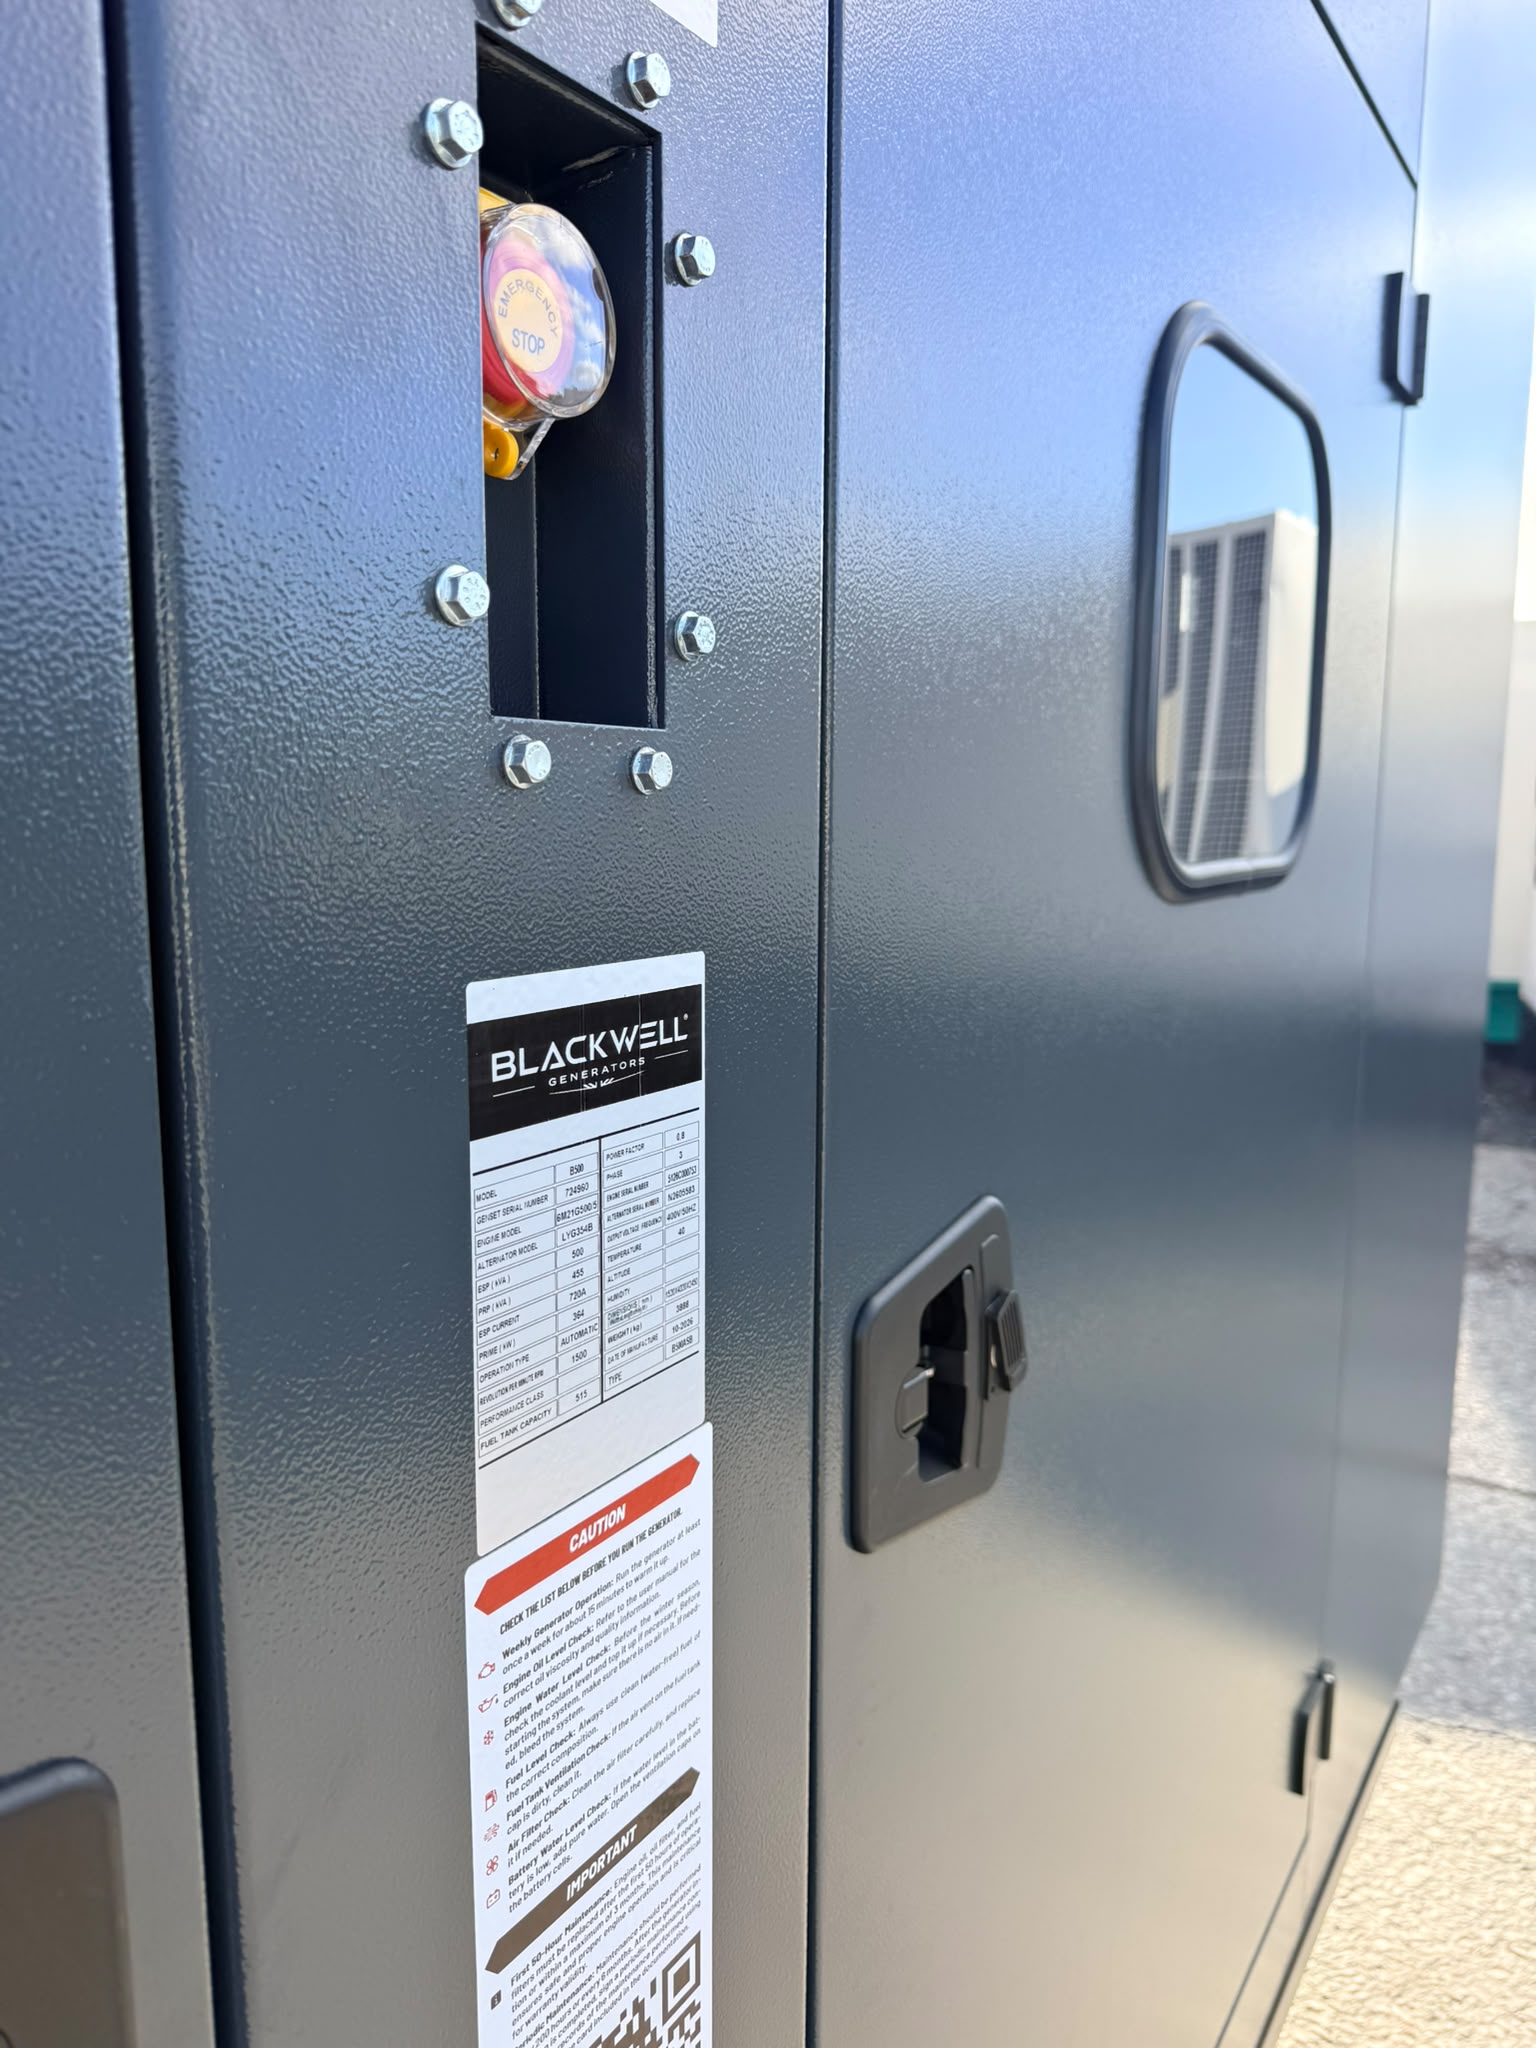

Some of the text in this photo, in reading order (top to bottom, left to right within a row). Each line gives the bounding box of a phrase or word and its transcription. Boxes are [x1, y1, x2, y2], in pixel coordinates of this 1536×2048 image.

[499, 280, 558, 338] EMERGENCY
[512, 328, 546, 356] STOP
[491, 1016, 689, 1083] BLACKWELL
[548, 1057, 646, 1088] GENERATORS
[605, 1148, 624, 1161] POWER
[625, 1142, 645, 1155] FACTOR
[606, 1169, 623, 1180] PHASE
[475, 1162, 584, 1202] MODEL B500
[606, 1190, 620, 1202] ENGINE
[633, 1180, 649, 1192] NUMBER
[476, 1209, 501, 1225] GENSET
[502, 1203, 523, 1216] SERIAL
[523, 1194, 548, 1208] NUMBER
[606, 1207, 631, 1222] ALTERNATOR
[644, 1196, 659, 1208] NUMBER
[476, 1232, 500, 1248] ENGINE
[500, 1226, 522, 1239] MODEL
[477, 1222, 593, 1271] ALTERNATOR MODEL LYG354B
[607, 1242, 642, 1262] TEMPERATURE
[477, 1281, 490, 1294] ESP
[571, 1246, 584, 1259] 500
[477, 1304, 491, 1316] PRP
[571, 1267, 584, 1279] 455
[607, 1267, 631, 1283] ALTITUDE
[607, 1287, 630, 1302] HUMIDITY
[478, 1287, 586, 1339] ESP CURRENT 720A
[478, 1345, 498, 1361] PRIME
[572, 1308, 585, 1321] 364
[607, 1327, 629, 1344] WEIGHT
[479, 1322, 598, 1384] OPERATION TYPE AUTOMATIC
[607, 1352, 620, 1364] DATE
[626, 1333, 658, 1354] MANUFACTURE
[479, 1386, 508, 1406] REVOLUTION
[571, 1348, 587, 1363] 1500
[608, 1370, 622, 1385] TYPE
[480, 1390, 544, 1428] PERFORMANCE CLASS
[480, 1388, 588, 1451] FUEL TANK CAPACITY 515
[569, 1503, 626, 1552] CAUTION
[499, 1506, 682, 1635] CHECK THE LIST BELOW BEFORE YOU RUN THE GENERATOR.
[501, 1634, 532, 1660] Weekly
[533, 1606, 573, 1639] Generator
[574, 1579, 614, 1611] Operation:
[615, 1568, 629, 1583] Run
[630, 1559, 642, 1572] the
[643, 1535, 676, 1565] generator
[685, 1518, 701, 1535] least
[502, 1655, 523, 1675] once
[530, 1635, 551, 1655] week
[552, 1627, 564, 1641] for
[564, 1610, 586, 1632] about
[595, 1585, 624, 1610] minutes
[633, 1565, 652, 1584] warm
[502, 1624, 594, 1694] Engine Oil Level Check:
[503, 1591, 660, 1708] correct oil viscosity and quality information.
[503, 1644, 611, 1728] Engine Water Level Check:
[504, 1705, 585, 1770] ed, bleed the system.
[505, 1729, 576, 1789] Fuel Level Check:
[505, 1726, 598, 1803] the correct composition.
[506, 1732, 611, 1822] Fuel Tank Ventilation Check:
[506, 1818, 522, 1835] cap
[531, 1794, 551, 1815] dirty,
[552, 1776, 573, 1798] clean
[507, 1796, 570, 1854] Air Filter Check:
[508, 1792, 611, 1886] Battery Water Level Check:
[522, 1823, 553, 1855] needed.
[566, 1824, 637, 1901] IMPORTANT
[508, 1854, 572, 1913] the battery cells.
[510, 1886, 612, 1987] First 50-Hour Maintenance:
[512, 1962, 587, 2040] for warranty validity.
